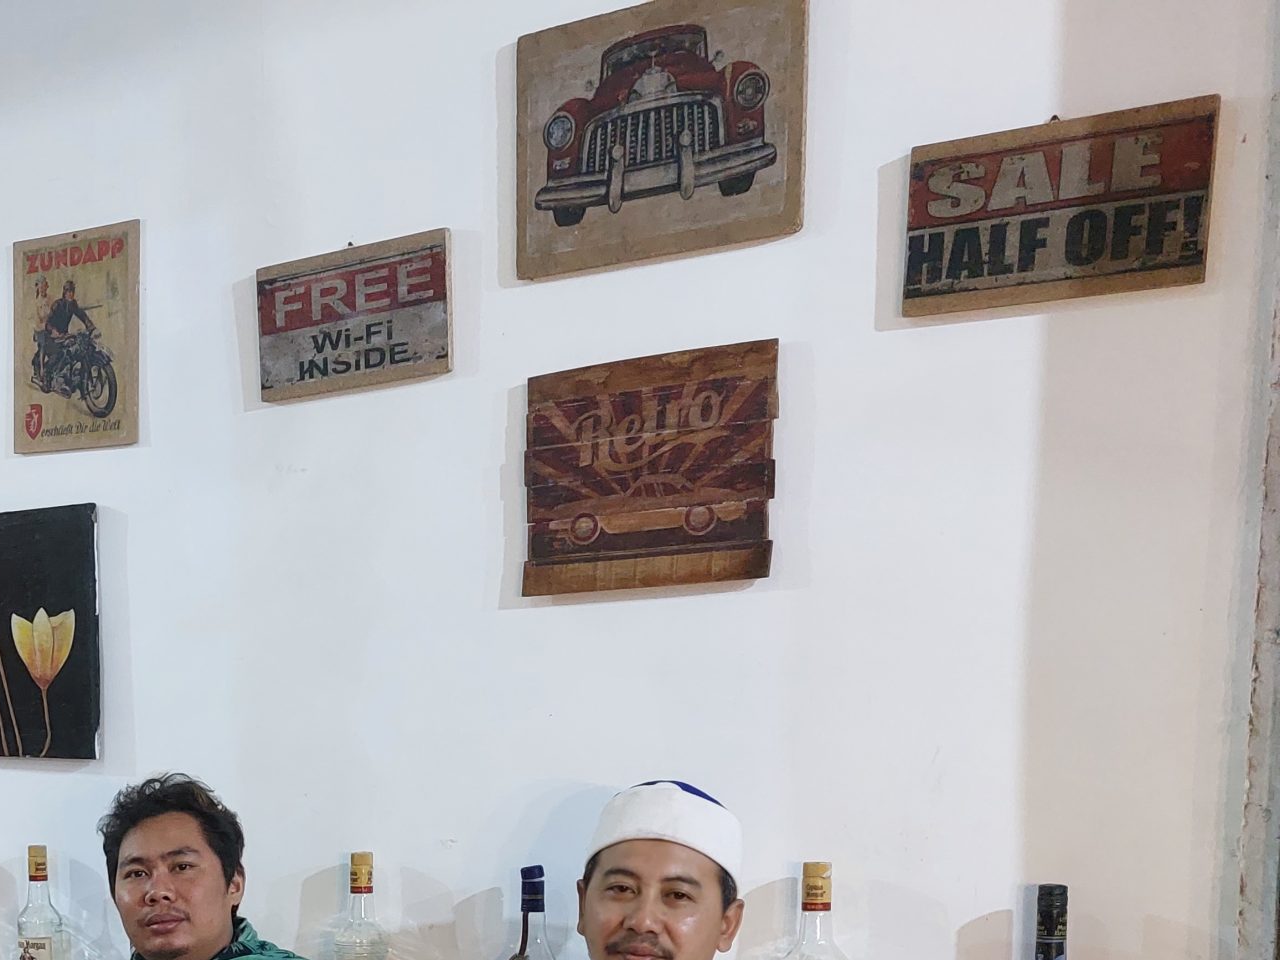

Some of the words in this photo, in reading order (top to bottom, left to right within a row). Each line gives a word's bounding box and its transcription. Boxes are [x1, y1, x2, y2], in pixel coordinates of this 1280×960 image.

[926, 132, 1164, 219] SALE
[906, 217, 1051, 287] HALF
[1064, 194, 1206, 267] OFF!
[273, 257, 435, 329] FREE
[298, 341, 412, 382] INSIDE
[311, 319, 394, 354] Wi-Fi
[572, 388, 727, 472] Retro
